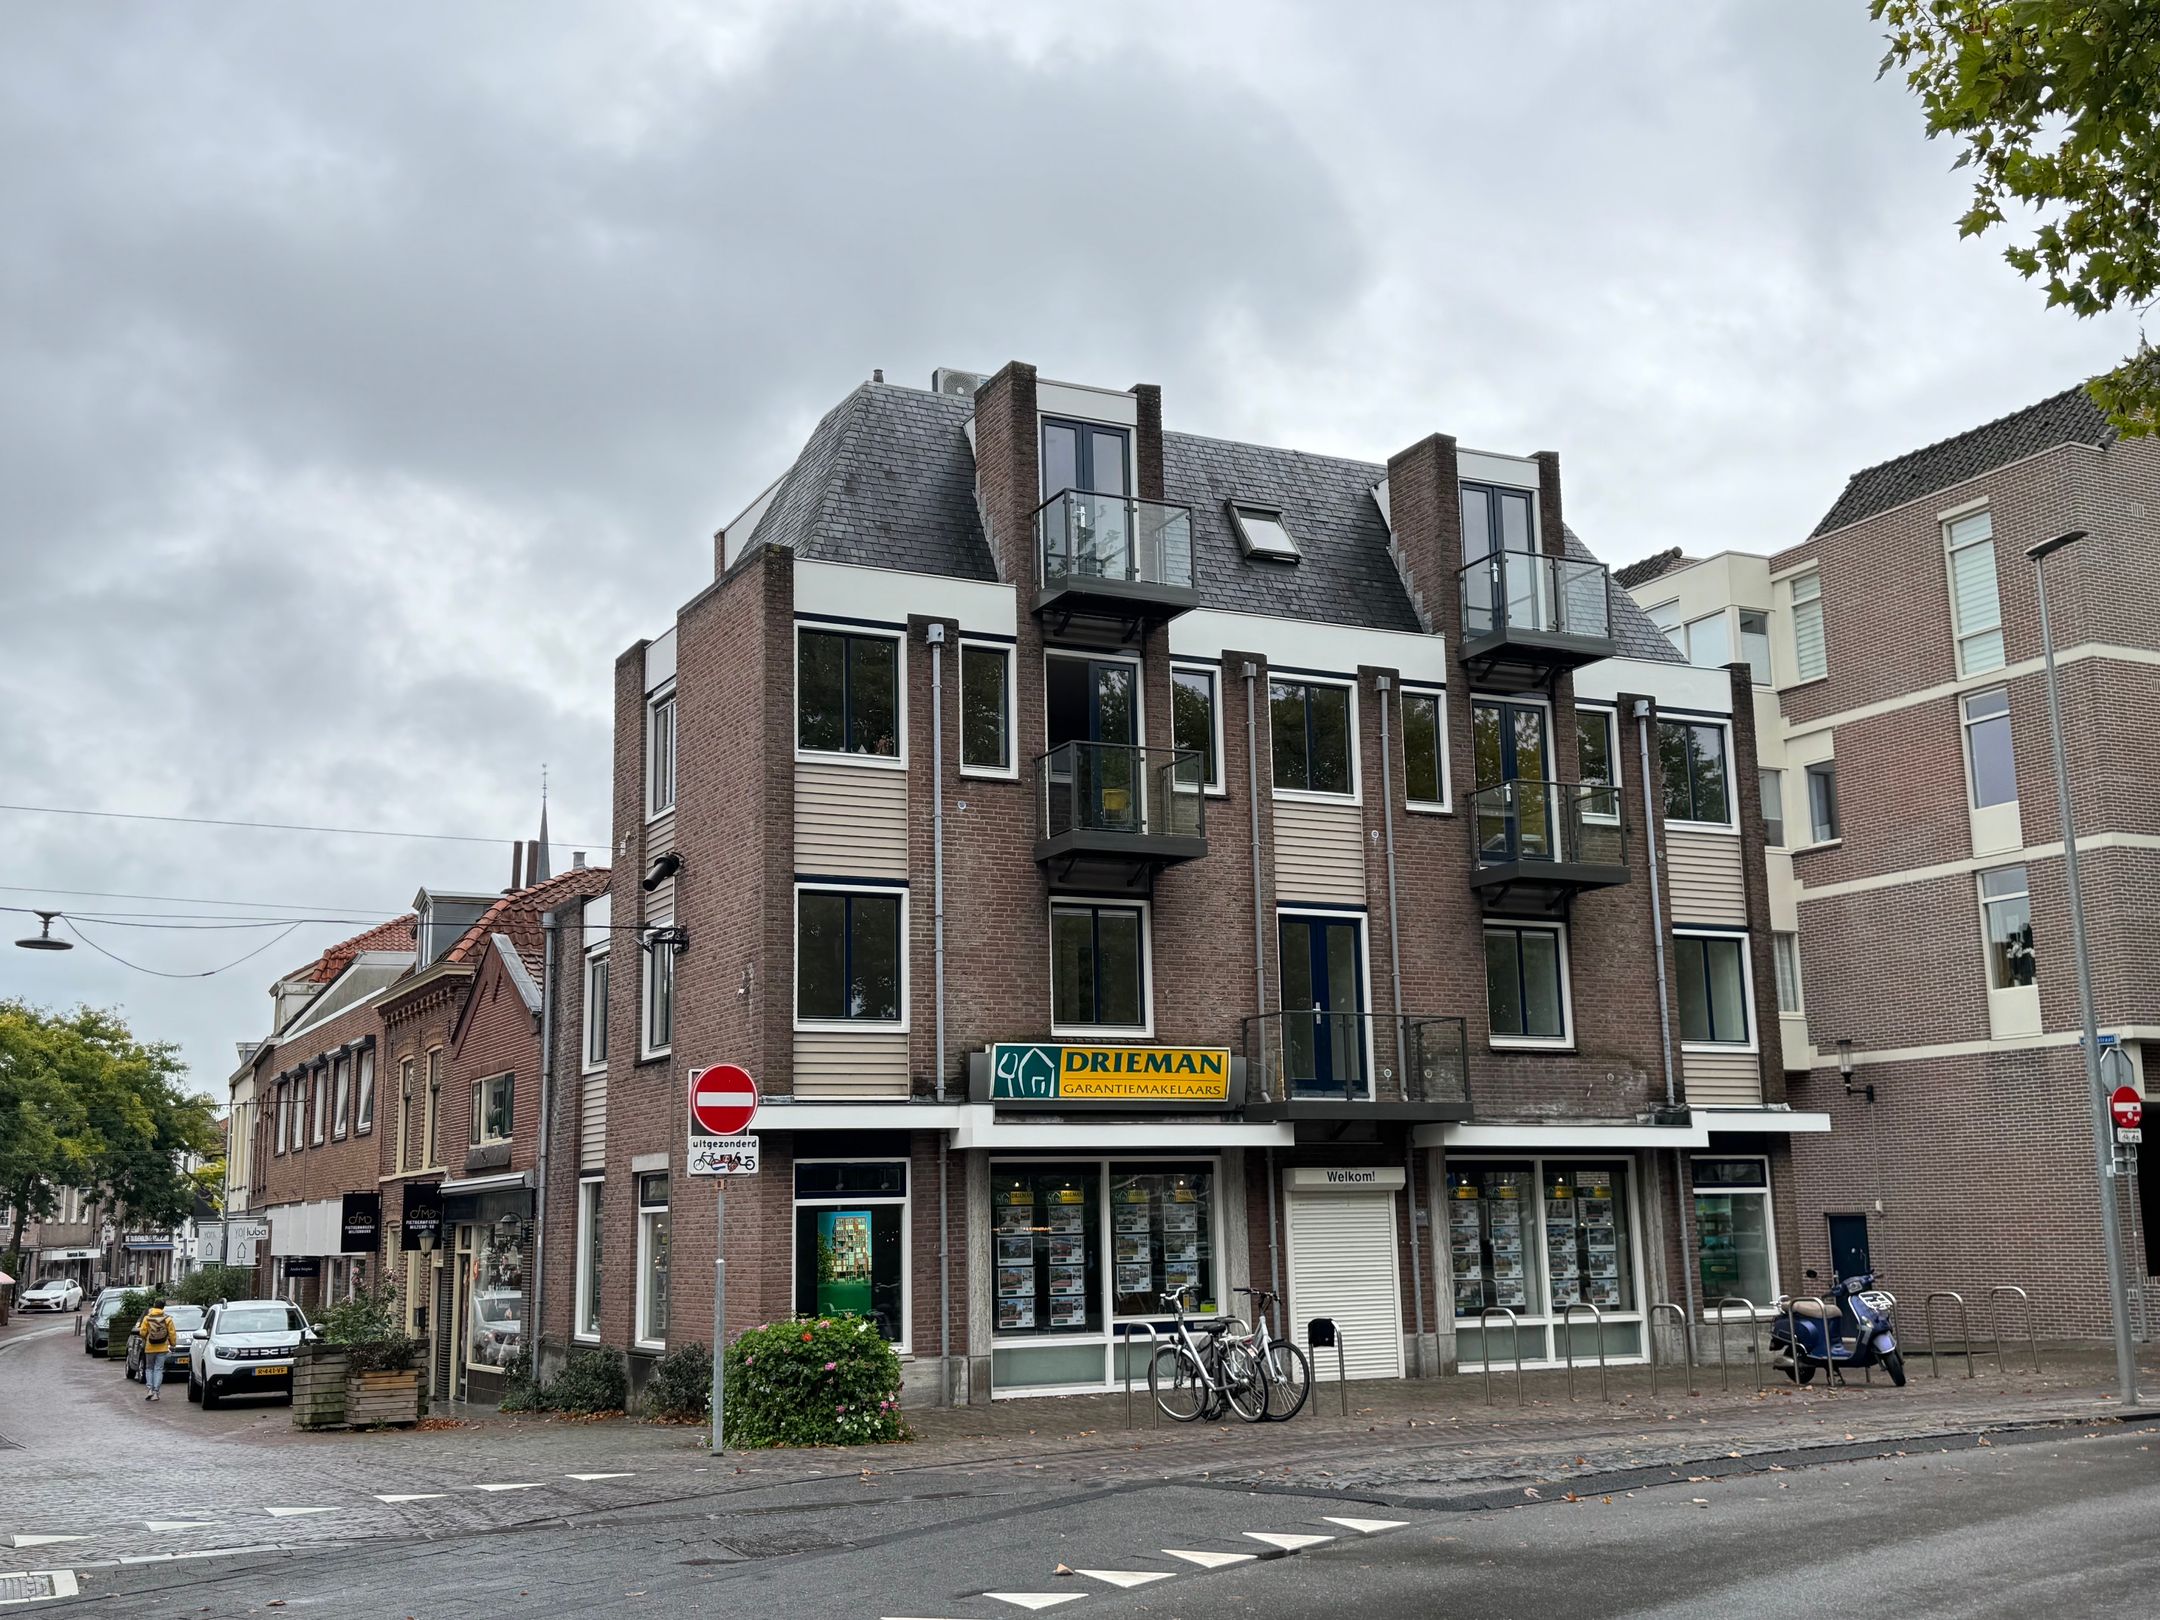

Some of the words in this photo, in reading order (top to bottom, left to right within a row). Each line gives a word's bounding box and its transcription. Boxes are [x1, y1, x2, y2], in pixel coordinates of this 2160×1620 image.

[1065, 1051, 1222, 1074] DRIEMAN
[1063, 1083, 1221, 1095] GARANTIEMAKELAARS
[693, 1140, 757, 1150] uitgezonderd
[1327, 1171, 1376, 1183] Welkom!
[246, 1227, 267, 1236] luba
